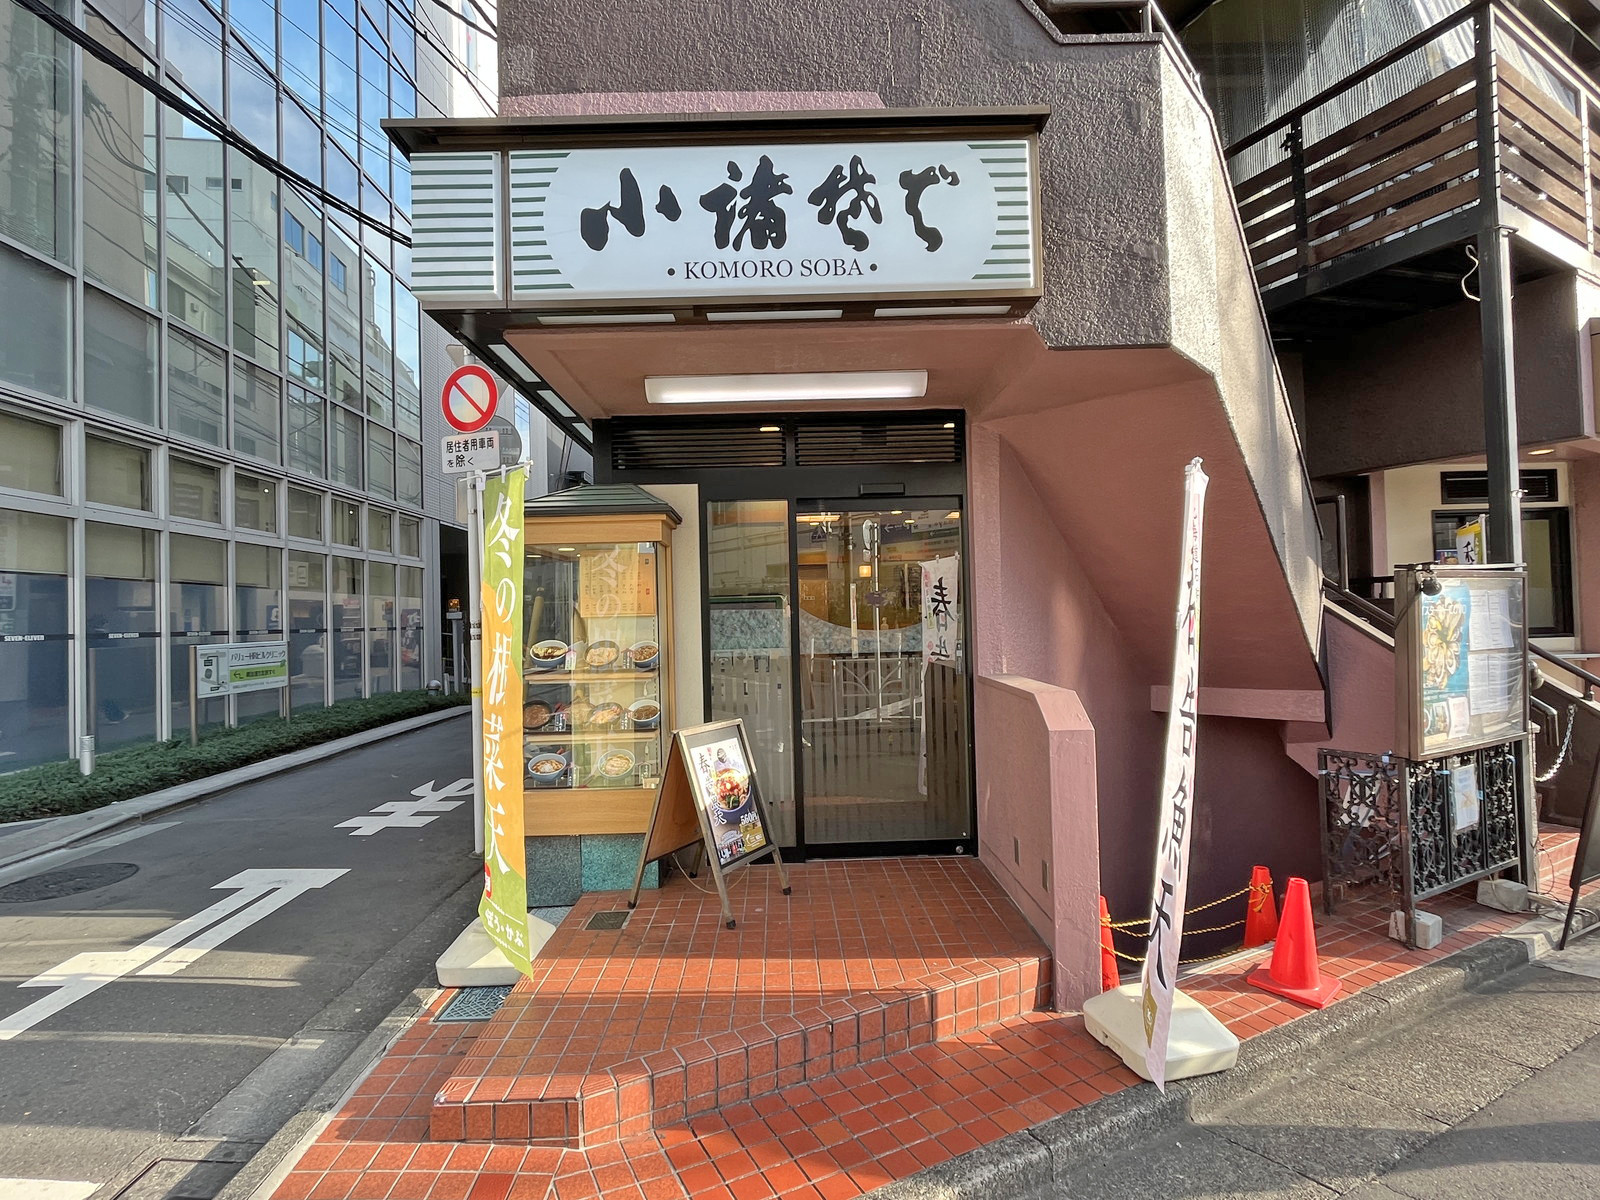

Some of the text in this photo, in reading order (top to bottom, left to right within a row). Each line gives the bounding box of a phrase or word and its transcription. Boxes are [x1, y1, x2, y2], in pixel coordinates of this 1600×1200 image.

[684, 257, 864, 280] KOMORO SOBA
[446, 437, 494, 453] 居住者用車両
[447, 454, 474, 468] を除く
